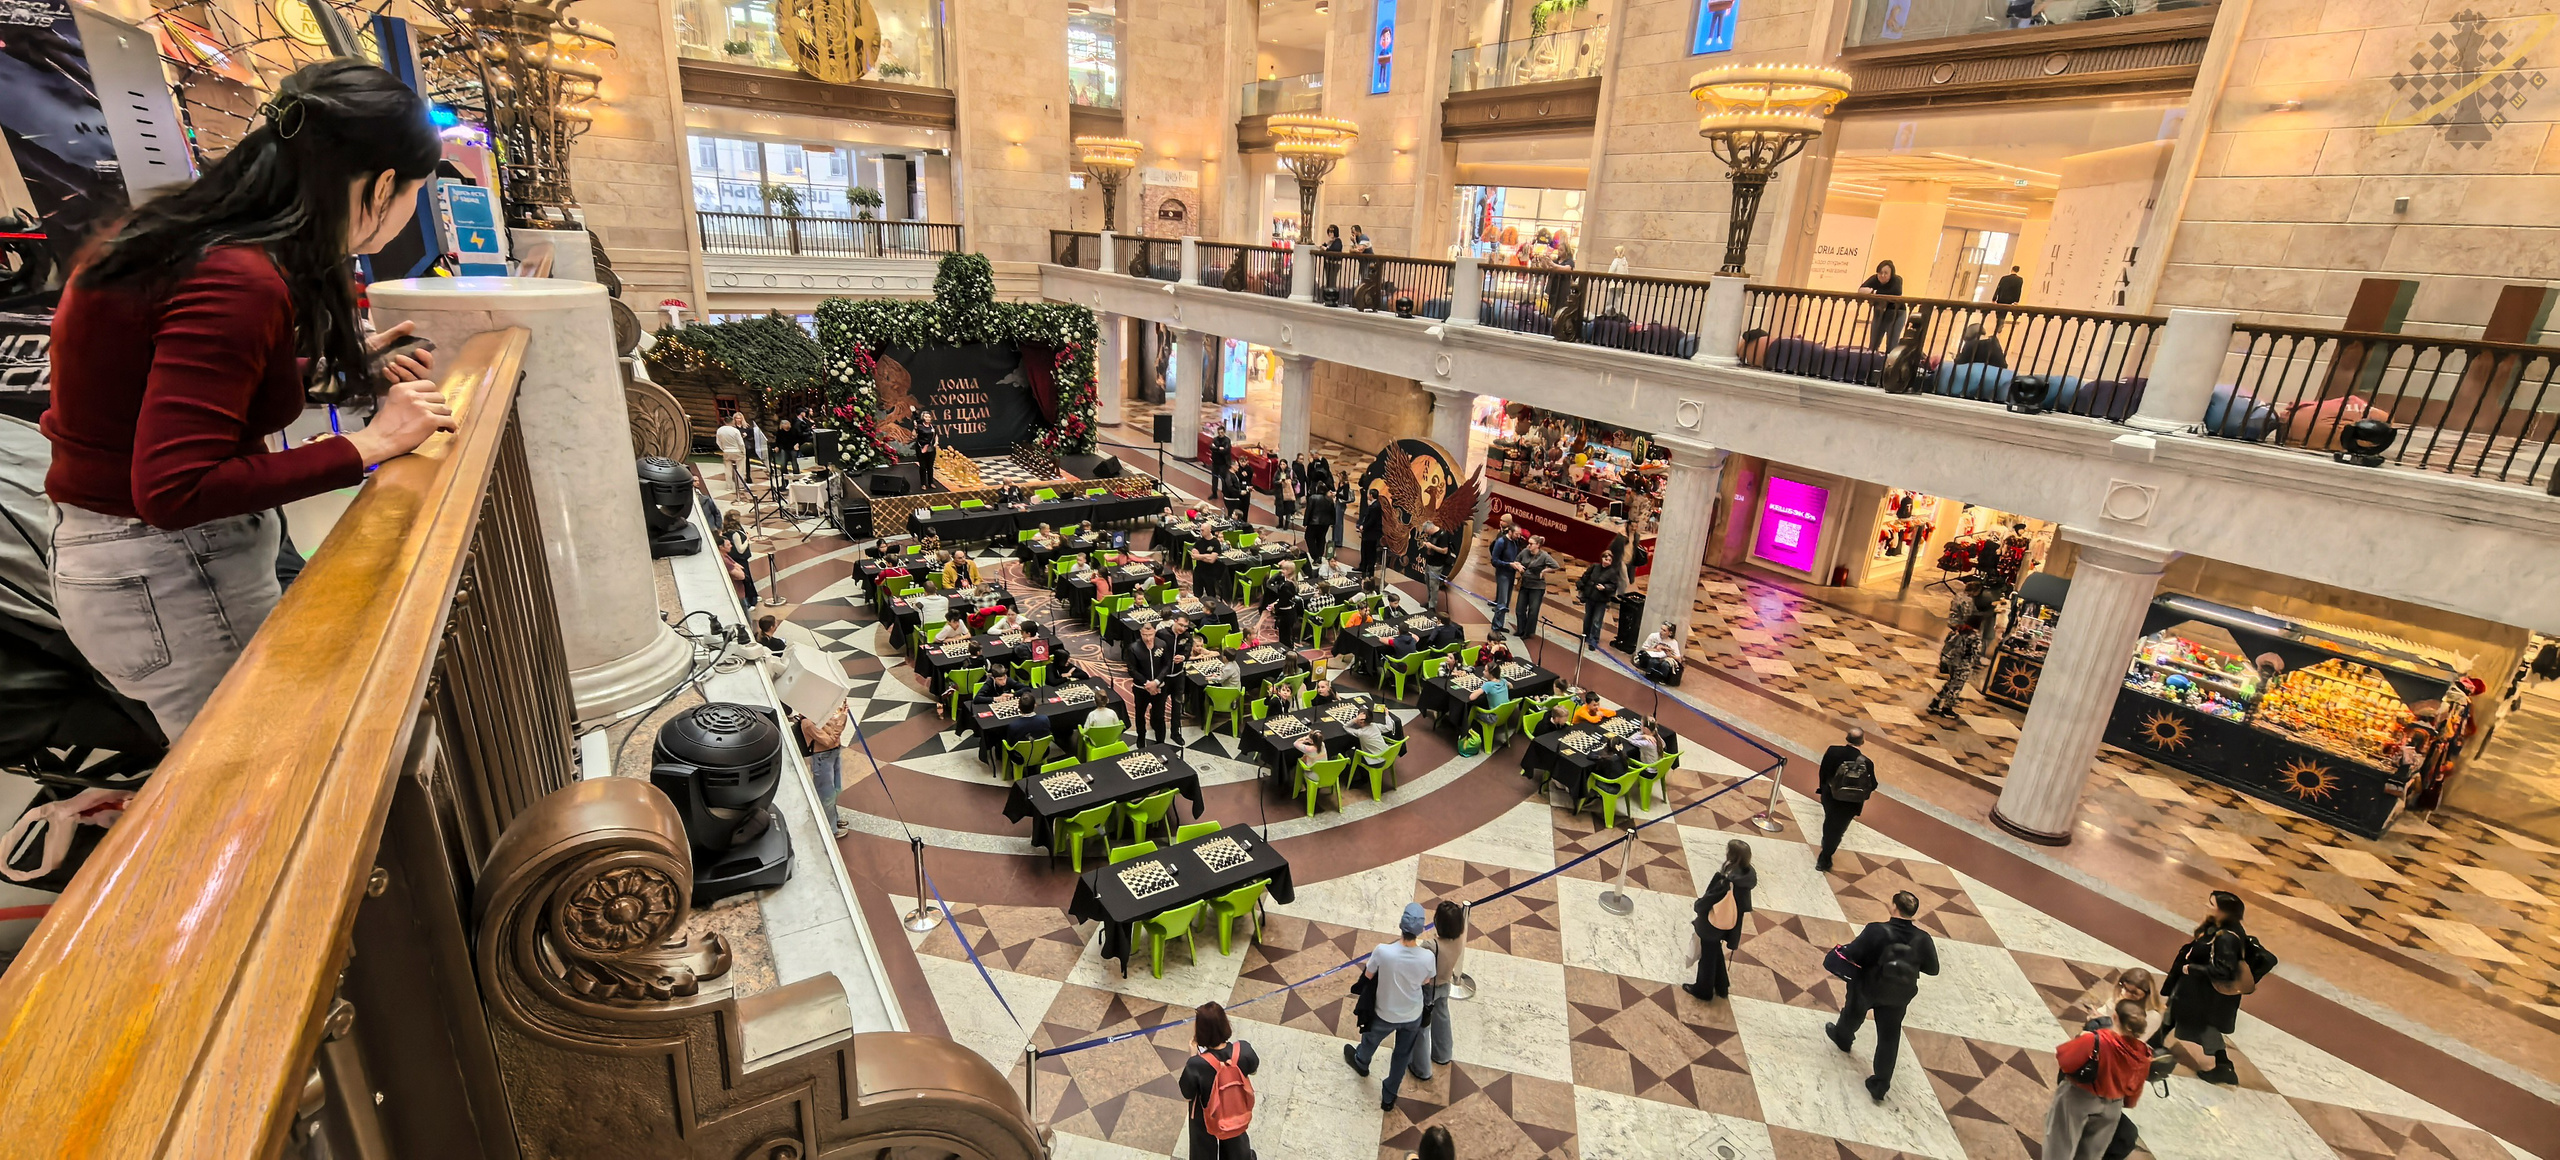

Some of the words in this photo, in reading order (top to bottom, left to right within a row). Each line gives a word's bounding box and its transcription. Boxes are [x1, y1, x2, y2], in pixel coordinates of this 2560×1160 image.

[1814, 245, 1835, 255] ORIA
[1835, 246, 1858, 257] JEANS
[2107, 247, 2140, 306] ЦДМ
[937, 377, 980, 392] ДОМА
[929, 392, 989, 406] ХОРОШО
[956, 406, 991, 421] ЦДМ
[1504, 504, 1534, 521] УПАКОВКА
[1534, 515, 1568, 533] ПОДАРКОВ
